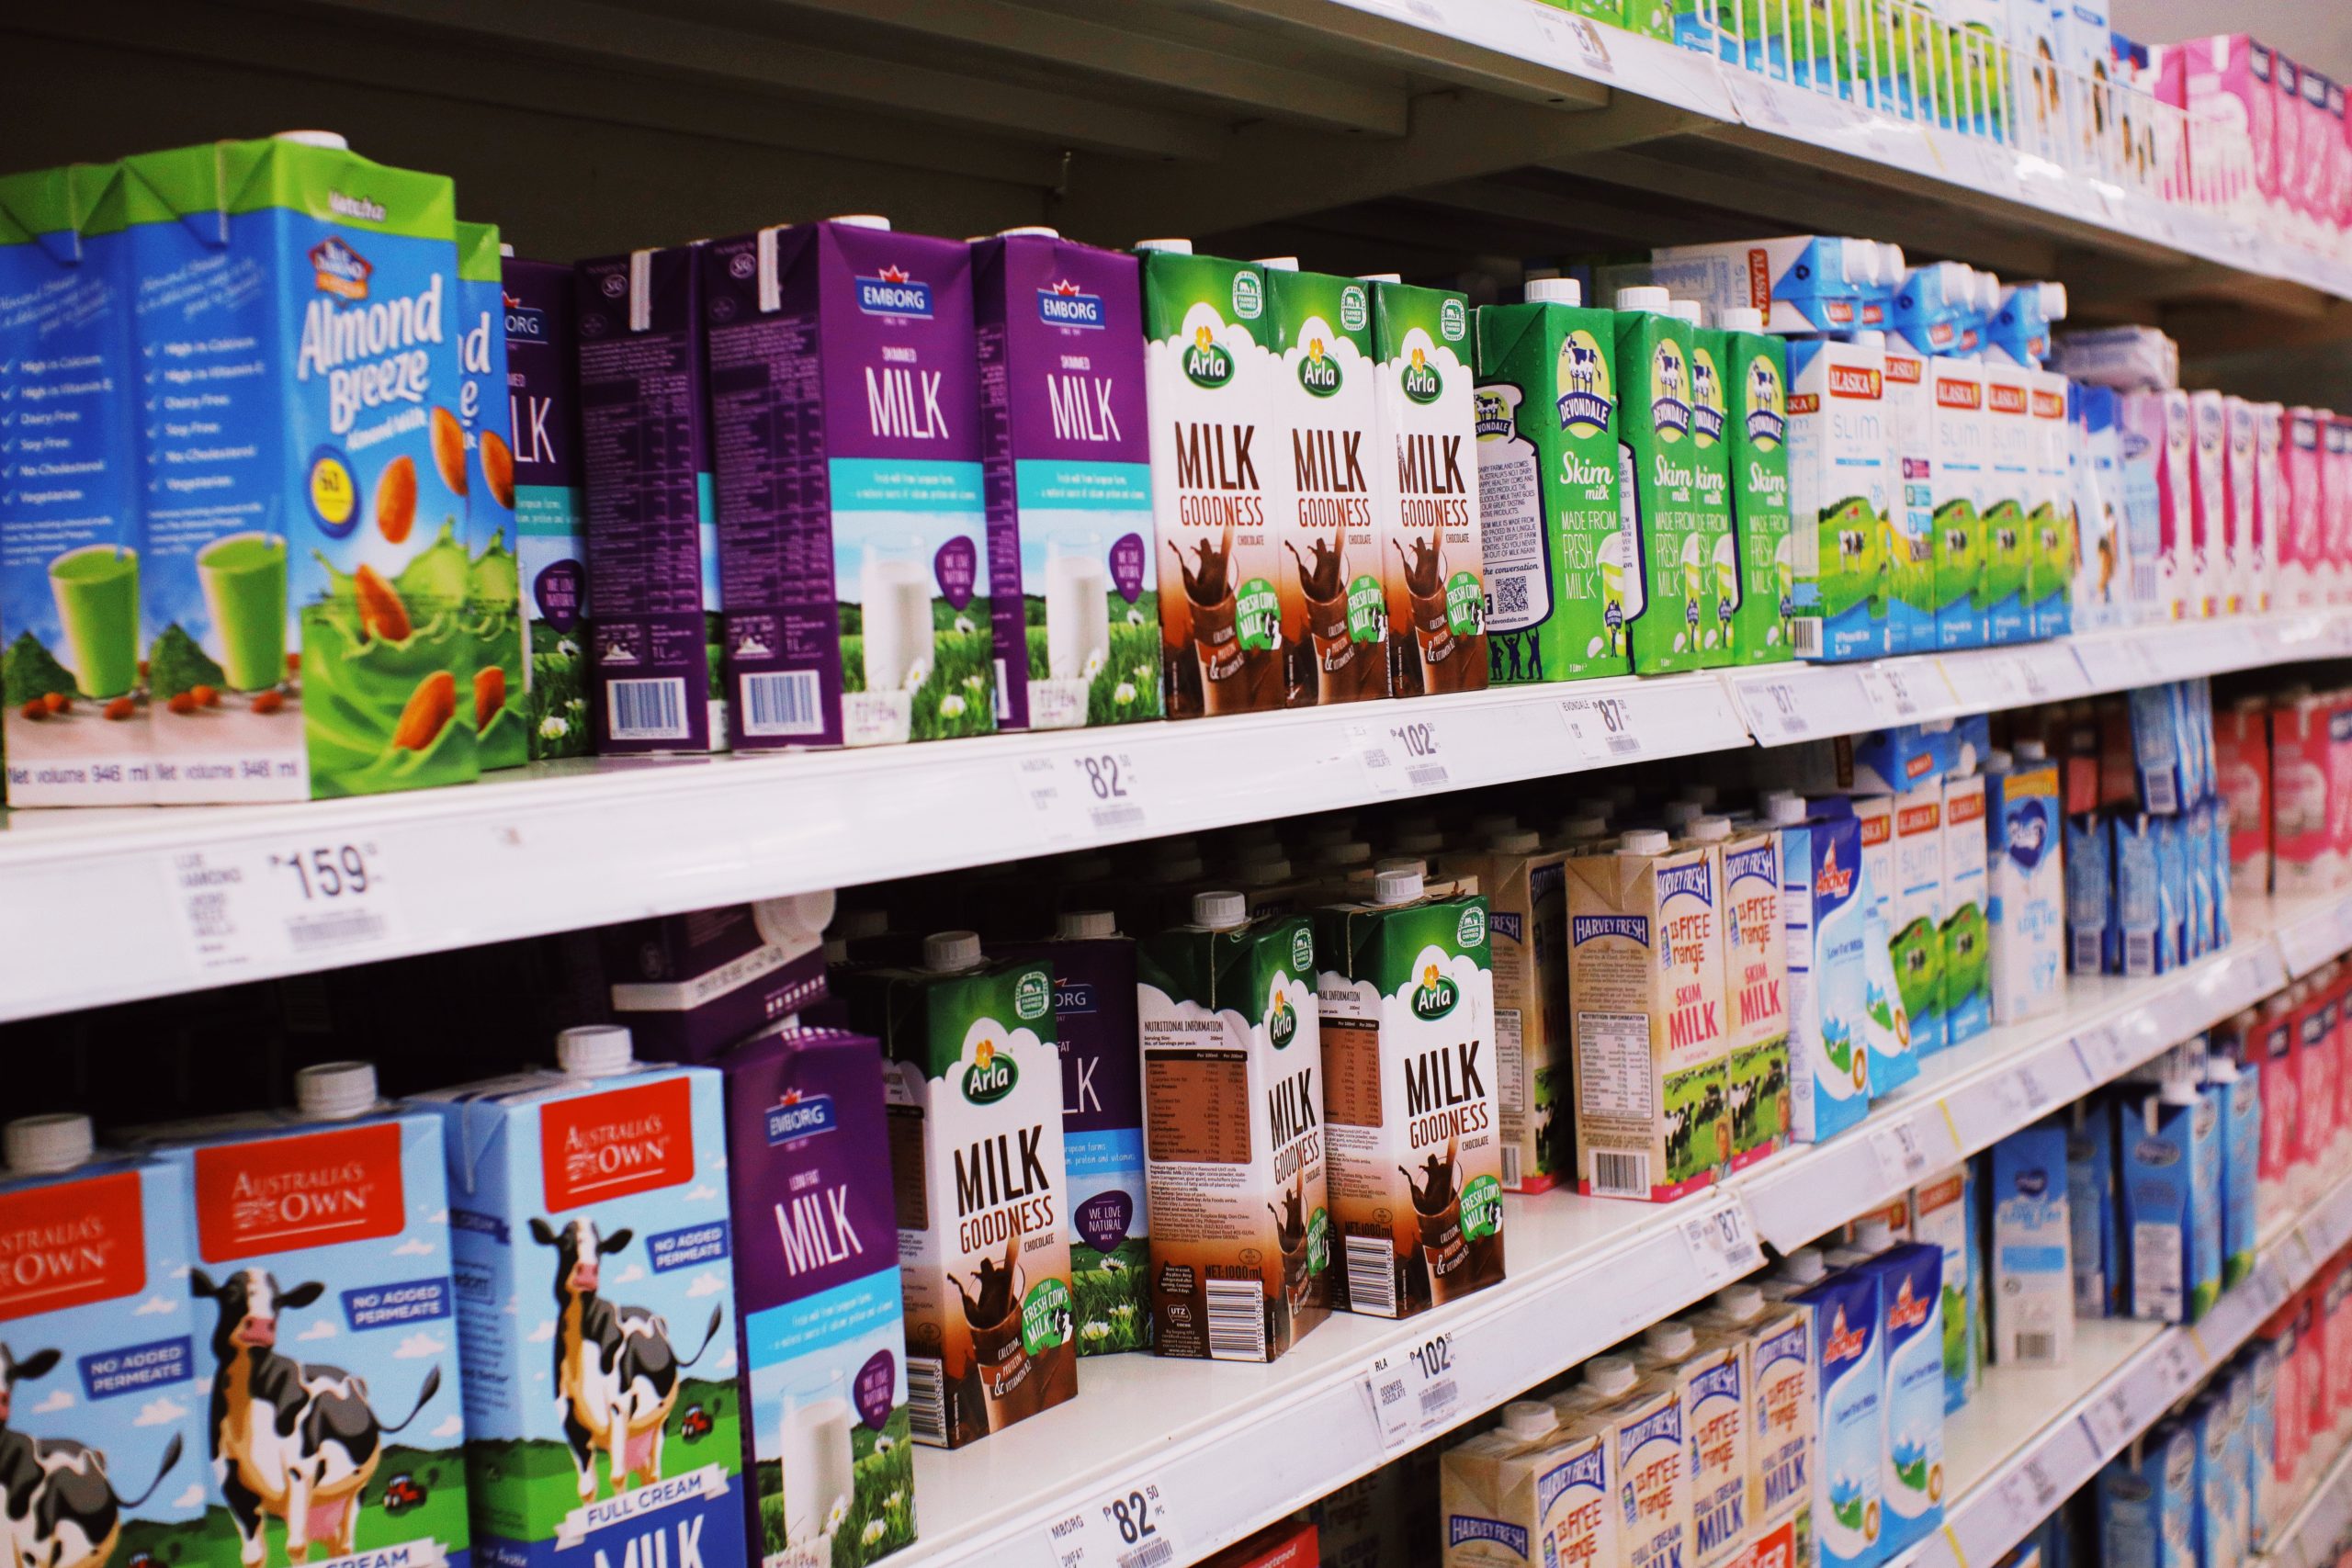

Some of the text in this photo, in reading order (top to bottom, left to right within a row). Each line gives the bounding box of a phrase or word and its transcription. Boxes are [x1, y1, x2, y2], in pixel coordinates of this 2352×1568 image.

[864, 287, 925, 310] EMBORG
[1043, 299, 1097, 321] EMBORG
[299, 274, 444, 381] Almond
[1189, 353, 1226, 378] Arla
[1304, 360, 1335, 388] Arla
[329, 349, 430, 434] Breeze
[1407, 370, 1435, 393] Arla
[1830, 371, 1870, 394] ALASKA
[1939, 383, 1972, 402] ALASKA
[865, 367, 949, 439] MILK
[1046, 373, 1122, 442] MILK
[1559, 398, 1607, 424] DEVONDALE
[1653, 398, 1689, 430] DEVONDALE
[1476, 422, 1509, 434] EVONDALE
[1749, 412, 1783, 441] DEVONDALE
[1175, 422, 1260, 490] MILK
[1292, 428, 1367, 492] MILK
[1396, 434, 1464, 494] MILK
[1560, 451, 1614, 485] Skim
[1654, 454, 1693, 487] Skim
[1695, 464, 1725, 491] kim
[1748, 461, 1787, 492] Skim
[1585, 484, 1610, 501] milk
[1672, 485, 1690, 502] milk
[1704, 490, 1723, 505] milk
[1767, 492, 1784, 506] milk
[1180, 495, 1264, 526] GOODNESS
[1298, 498, 1371, 527] GOODNESS
[1401, 499, 1469, 527] GOODNESS
[1561, 511, 1617, 530] MADE FROM
[1656, 511, 1696, 530] MADE FROM
[1707, 513, 1728, 531] FROM
[1749, 513, 1790, 533] MADE FROM
[1238, 535, 1264, 546] CHOCOLATE
[1349, 535, 1372, 545] CHOCOLATE
[1446, 533, 1470, 543] CHOCOLATE
[1563, 534, 1594, 570] FRESH
[1656, 534, 1679, 568] FRESH
[1750, 535, 1773, 567] FRESH
[1495, 562, 1539, 574] conversation
[1752, 570, 1775, 594] MILK
[1447, 587, 1465, 607] FRESH
[1566, 572, 1596, 600] MILK
[1657, 571, 1681, 596] MILK
[1237, 592, 1260, 618] FRESH
[1347, 592, 1367, 613] FRESH
[1450, 603, 1468, 626] MILK
[1240, 613, 1262, 640] MILK
[1351, 608, 1369, 634] MILK
[1325, 648, 1333, 671] &
[1428, 640, 1436, 662] &
[1209, 655, 1220, 680] &
[1598, 699, 1624, 732] 87
[1398, 724, 1436, 757] 102
[1085, 755, 1127, 799] 82
[288, 844, 368, 900] 159
[1726, 849, 1774, 891] HARVEY FRESH
[1816, 867, 1852, 897] Anchor
[1657, 866, 1709, 911] HARVEY FRESH
[1490, 913, 1520, 941] FRESH
[1576, 919, 1646, 943] HARVEY FRESH
[1745, 962, 1768, 986] SKIM
[1329, 990, 1361, 1002] INFORMATION
[1418, 984, 1451, 1011] Arla
[1676, 982, 1702, 1008] SKIM
[1739, 979, 1782, 1028] MILK
[1144, 1021, 1224, 1032] NUTRITIONAL INFORMATION
[1270, 1014, 1293, 1039] Arla
[1668, 1000, 1719, 1051] MILK
[969, 1062, 1009, 1096] Arla
[1404, 1040, 1486, 1118] MILK
[770, 1104, 825, 1136] EMBORG
[1269, 1067, 1317, 1152] MILK
[564, 1114, 663, 1154] AUSTRALIA'S
[1409, 1101, 1488, 1149] GOODNESS
[597, 1140, 665, 1175] OWN
[1462, 1135, 1489, 1152] CHOCOLATE
[954, 1124, 1050, 1218] MILK
[1274, 1131, 1319, 1185] GOODNESS
[232, 1162, 365, 1197] AUSTRALIA'S
[1305, 1166, 1321, 1184] CHOCOLATE
[279, 1186, 367, 1223] OWN
[1089, 1205, 1122, 1220] WE LOVE
[1460, 1182, 1500, 1215] FRESH COW'S
[775, 1184, 864, 1277] MILK
[960, 1194, 1055, 1255] GOODNESS
[1089, 1219, 1123, 1233] NATURAL
[1464, 1204, 1486, 1234] MILK
[1718, 1209, 1740, 1243] 87
[654, 1228, 722, 1255] NO ADDED
[1023, 1233, 1055, 1253] CHOCOLATE
[1440, 1224, 1461, 1245] CALCIUM,
[1444, 1237, 1462, 1258] PROTEIN
[14, 1246, 104, 1285] OWN
[656, 1241, 724, 1269] PERMEATE
[1437, 1251, 1465, 1275] & VITAMIN
[353, 1283, 441, 1311] NO ADDED
[1023, 1285, 1069, 1327] FRESH COW'S
[1170, 1306, 1186, 1315] UTZ
[355, 1298, 442, 1327] PERMEATE
[1026, 1314, 1051, 1347] MILK
[91, 1346, 182, 1378] NO ADDED
[998, 1337, 1022, 1360] CALCIUM,
[1375, 1358, 1388, 1372] RLA
[1417, 1336, 1451, 1379] 102
[95, 1361, 183, 1393] PERMEATE
[1002, 1353, 1023, 1377] PROTEIN
[994, 1366, 1027, 1396] & VITAMIN
[1382, 1388, 1407, 1406] HOCOLATE
[1765, 1451, 1806, 1512] MILK
[587, 1475, 702, 1526] FULL CREAM
[1051, 1484, 1159, 1544] MBORG 82 50
[1453, 1517, 1526, 1555] HARVEY FRESH
[1697, 1494, 1744, 1557] MILK
[594, 1514, 707, 1568] MILK
